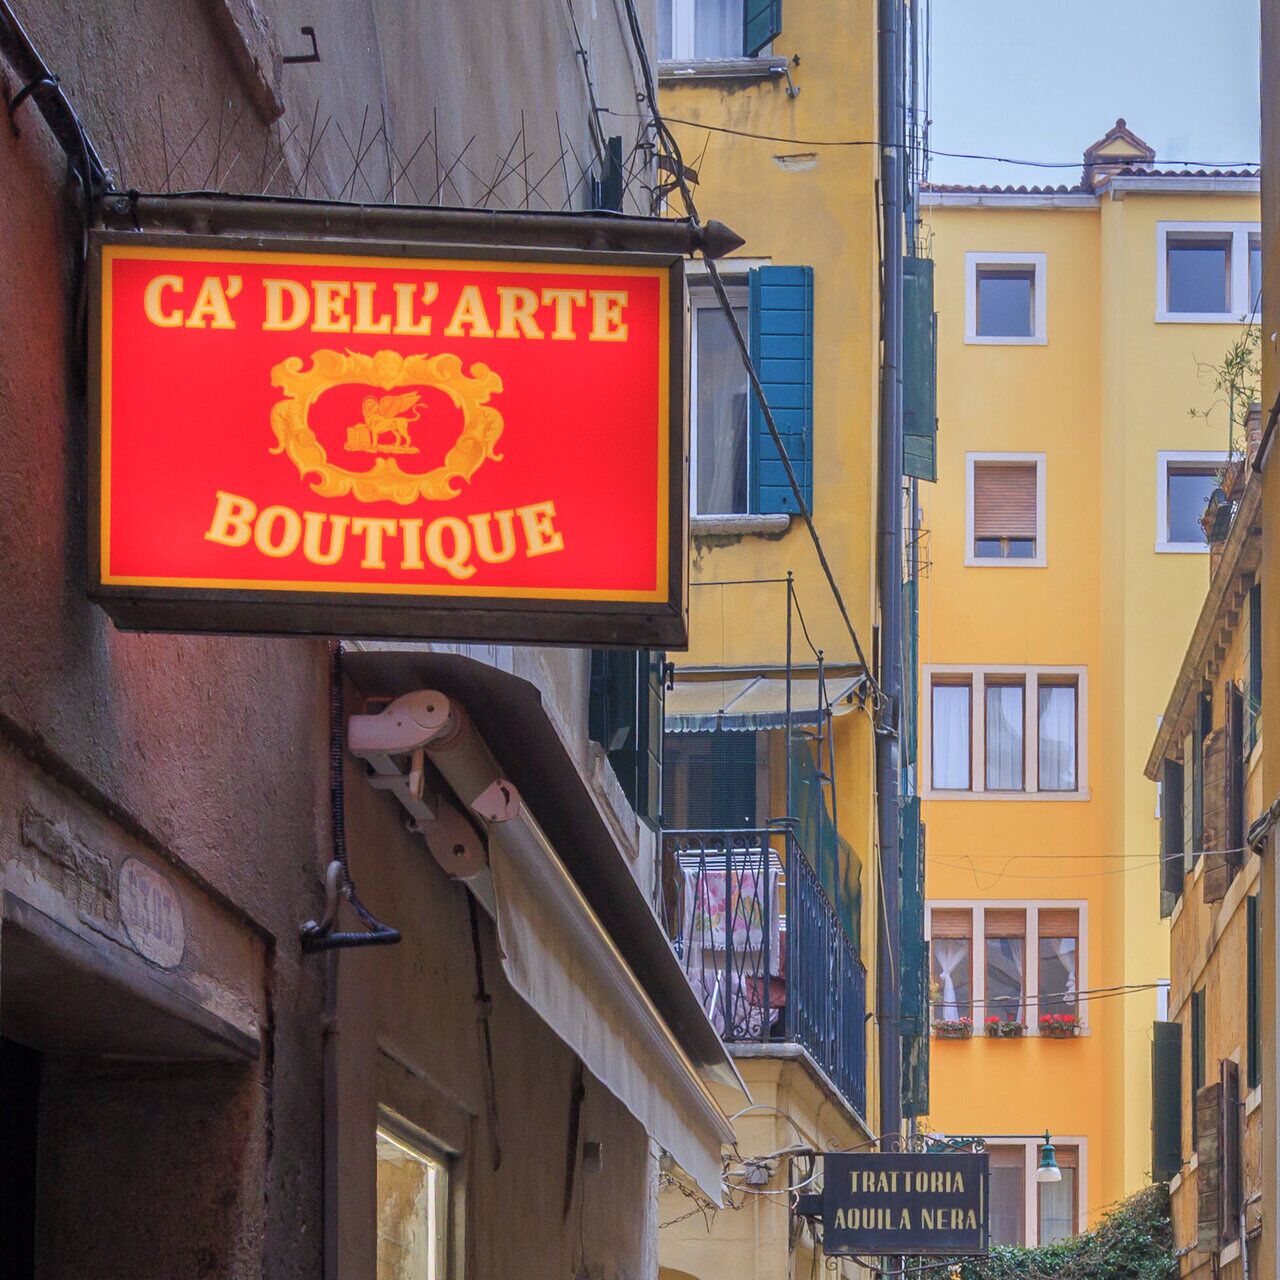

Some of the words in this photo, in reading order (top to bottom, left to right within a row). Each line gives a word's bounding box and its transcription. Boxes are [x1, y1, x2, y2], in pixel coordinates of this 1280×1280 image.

[143, 273, 242, 330] CA'
[204, 489, 564, 580] BOUTIQUE
[849, 1170, 965, 1195] TRATTORIA
[834, 1207, 912, 1231] AQUILA
[921, 1208, 978, 1230] NERA
